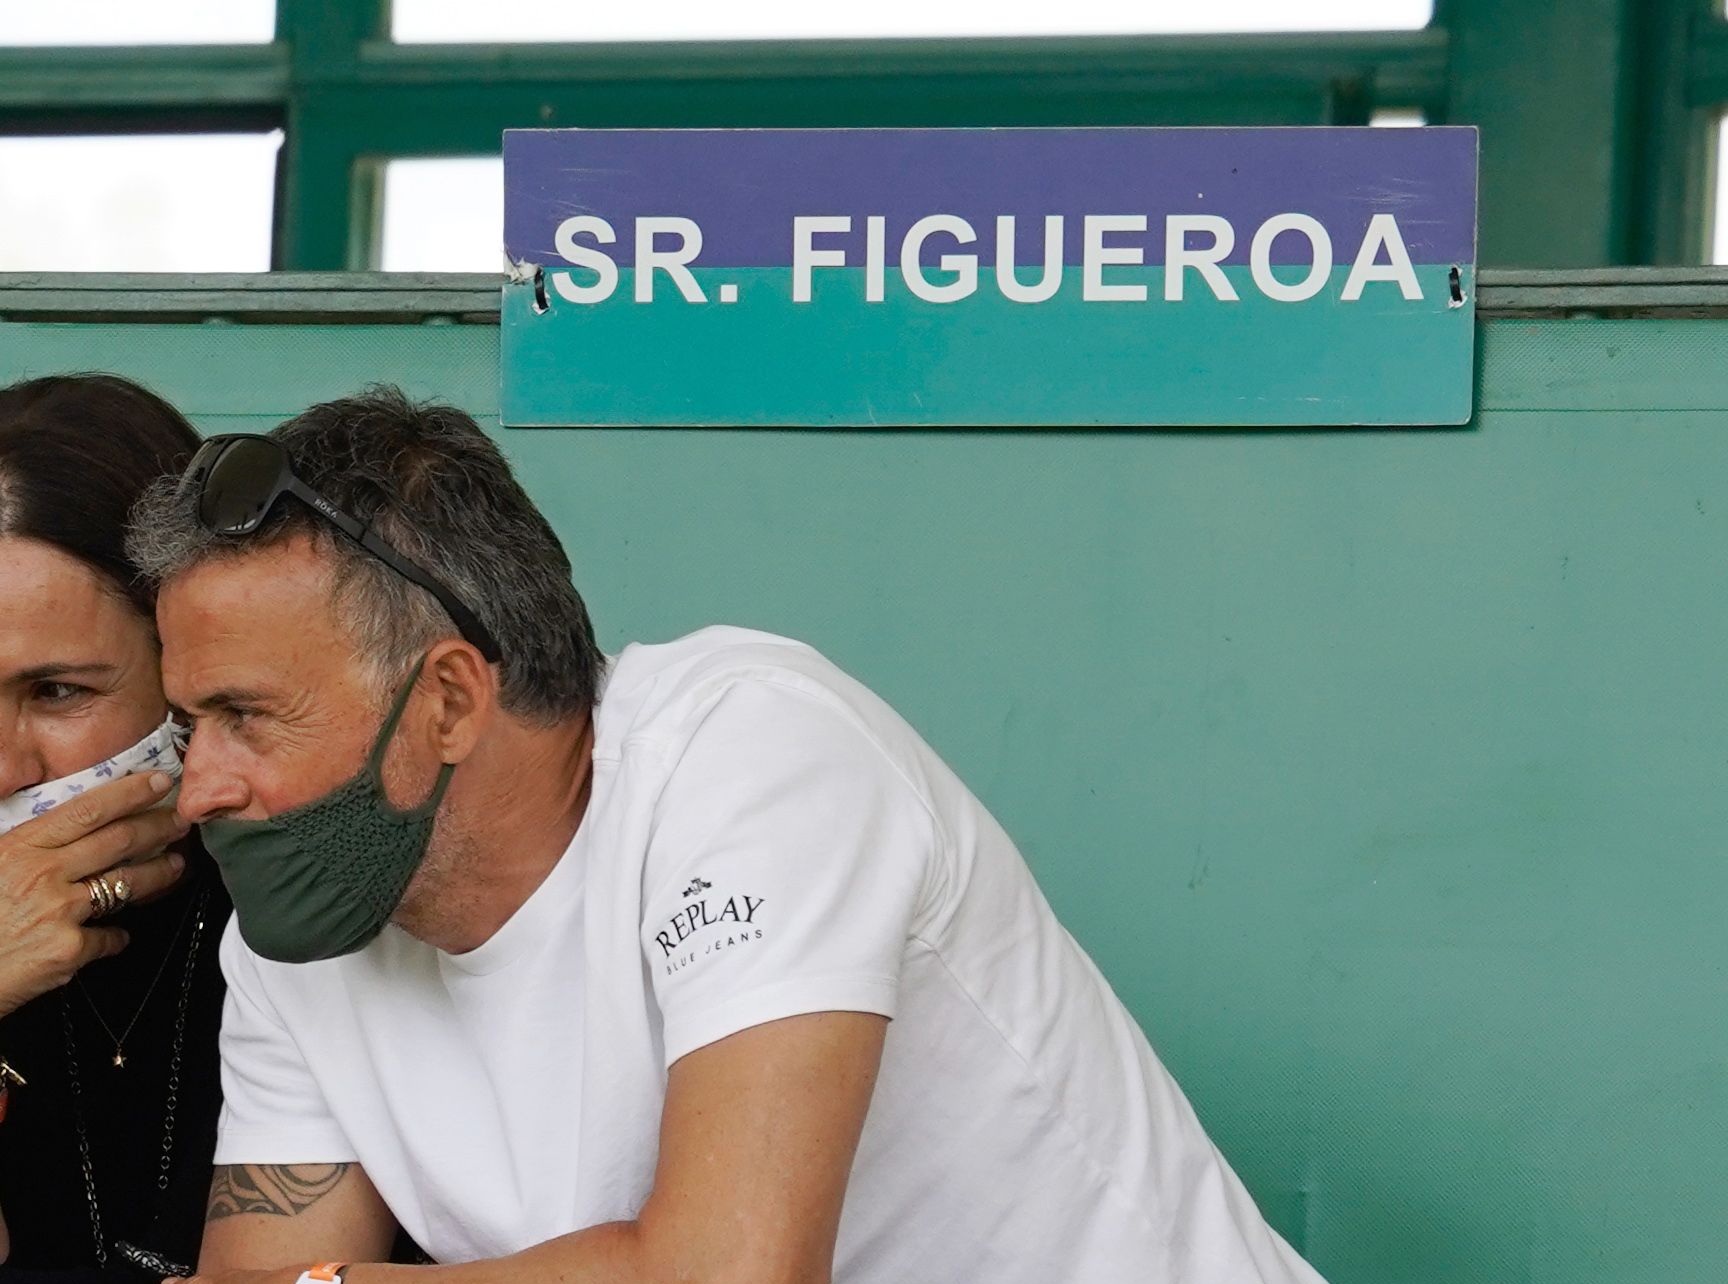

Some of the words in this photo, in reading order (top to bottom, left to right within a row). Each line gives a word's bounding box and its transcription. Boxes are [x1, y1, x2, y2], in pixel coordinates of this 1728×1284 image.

[551, 214, 738, 305] SR.
[791, 212, 1425, 304] FIGUEROA
[314, 498, 337, 518] ROKA
[655, 894, 766, 959] REPLAY
[666, 953, 696, 976] BLUE
[705, 929, 764, 955] JEANS
